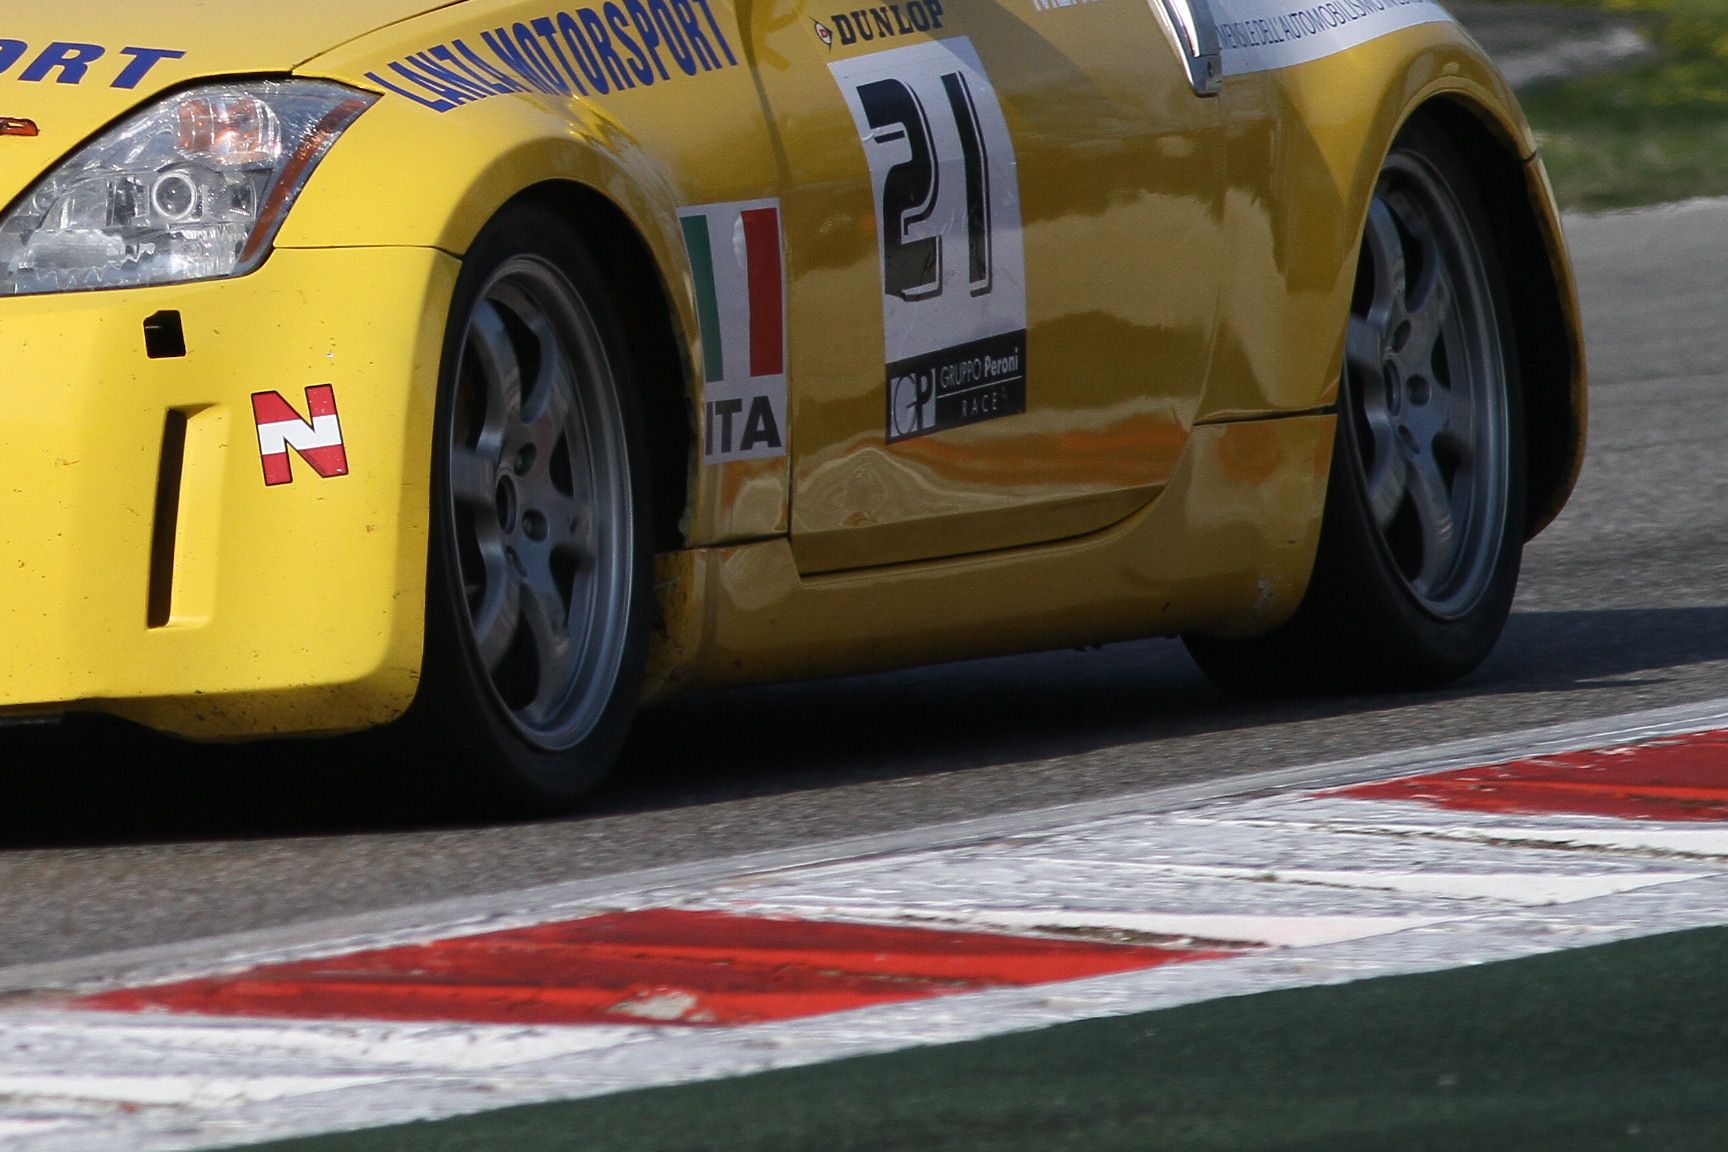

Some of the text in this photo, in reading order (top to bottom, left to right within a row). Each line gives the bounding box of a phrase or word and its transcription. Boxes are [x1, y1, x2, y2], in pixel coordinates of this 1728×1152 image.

[364, 39, 528, 113] LANZA
[856, 70, 992, 302] 21
[940, 358, 982, 388] GRUPPO
[984, 348, 1019, 377] Peroni
[251, 384, 349, 486] N
[705, 395, 782, 456] ITA
[962, 392, 999, 417] RACE
